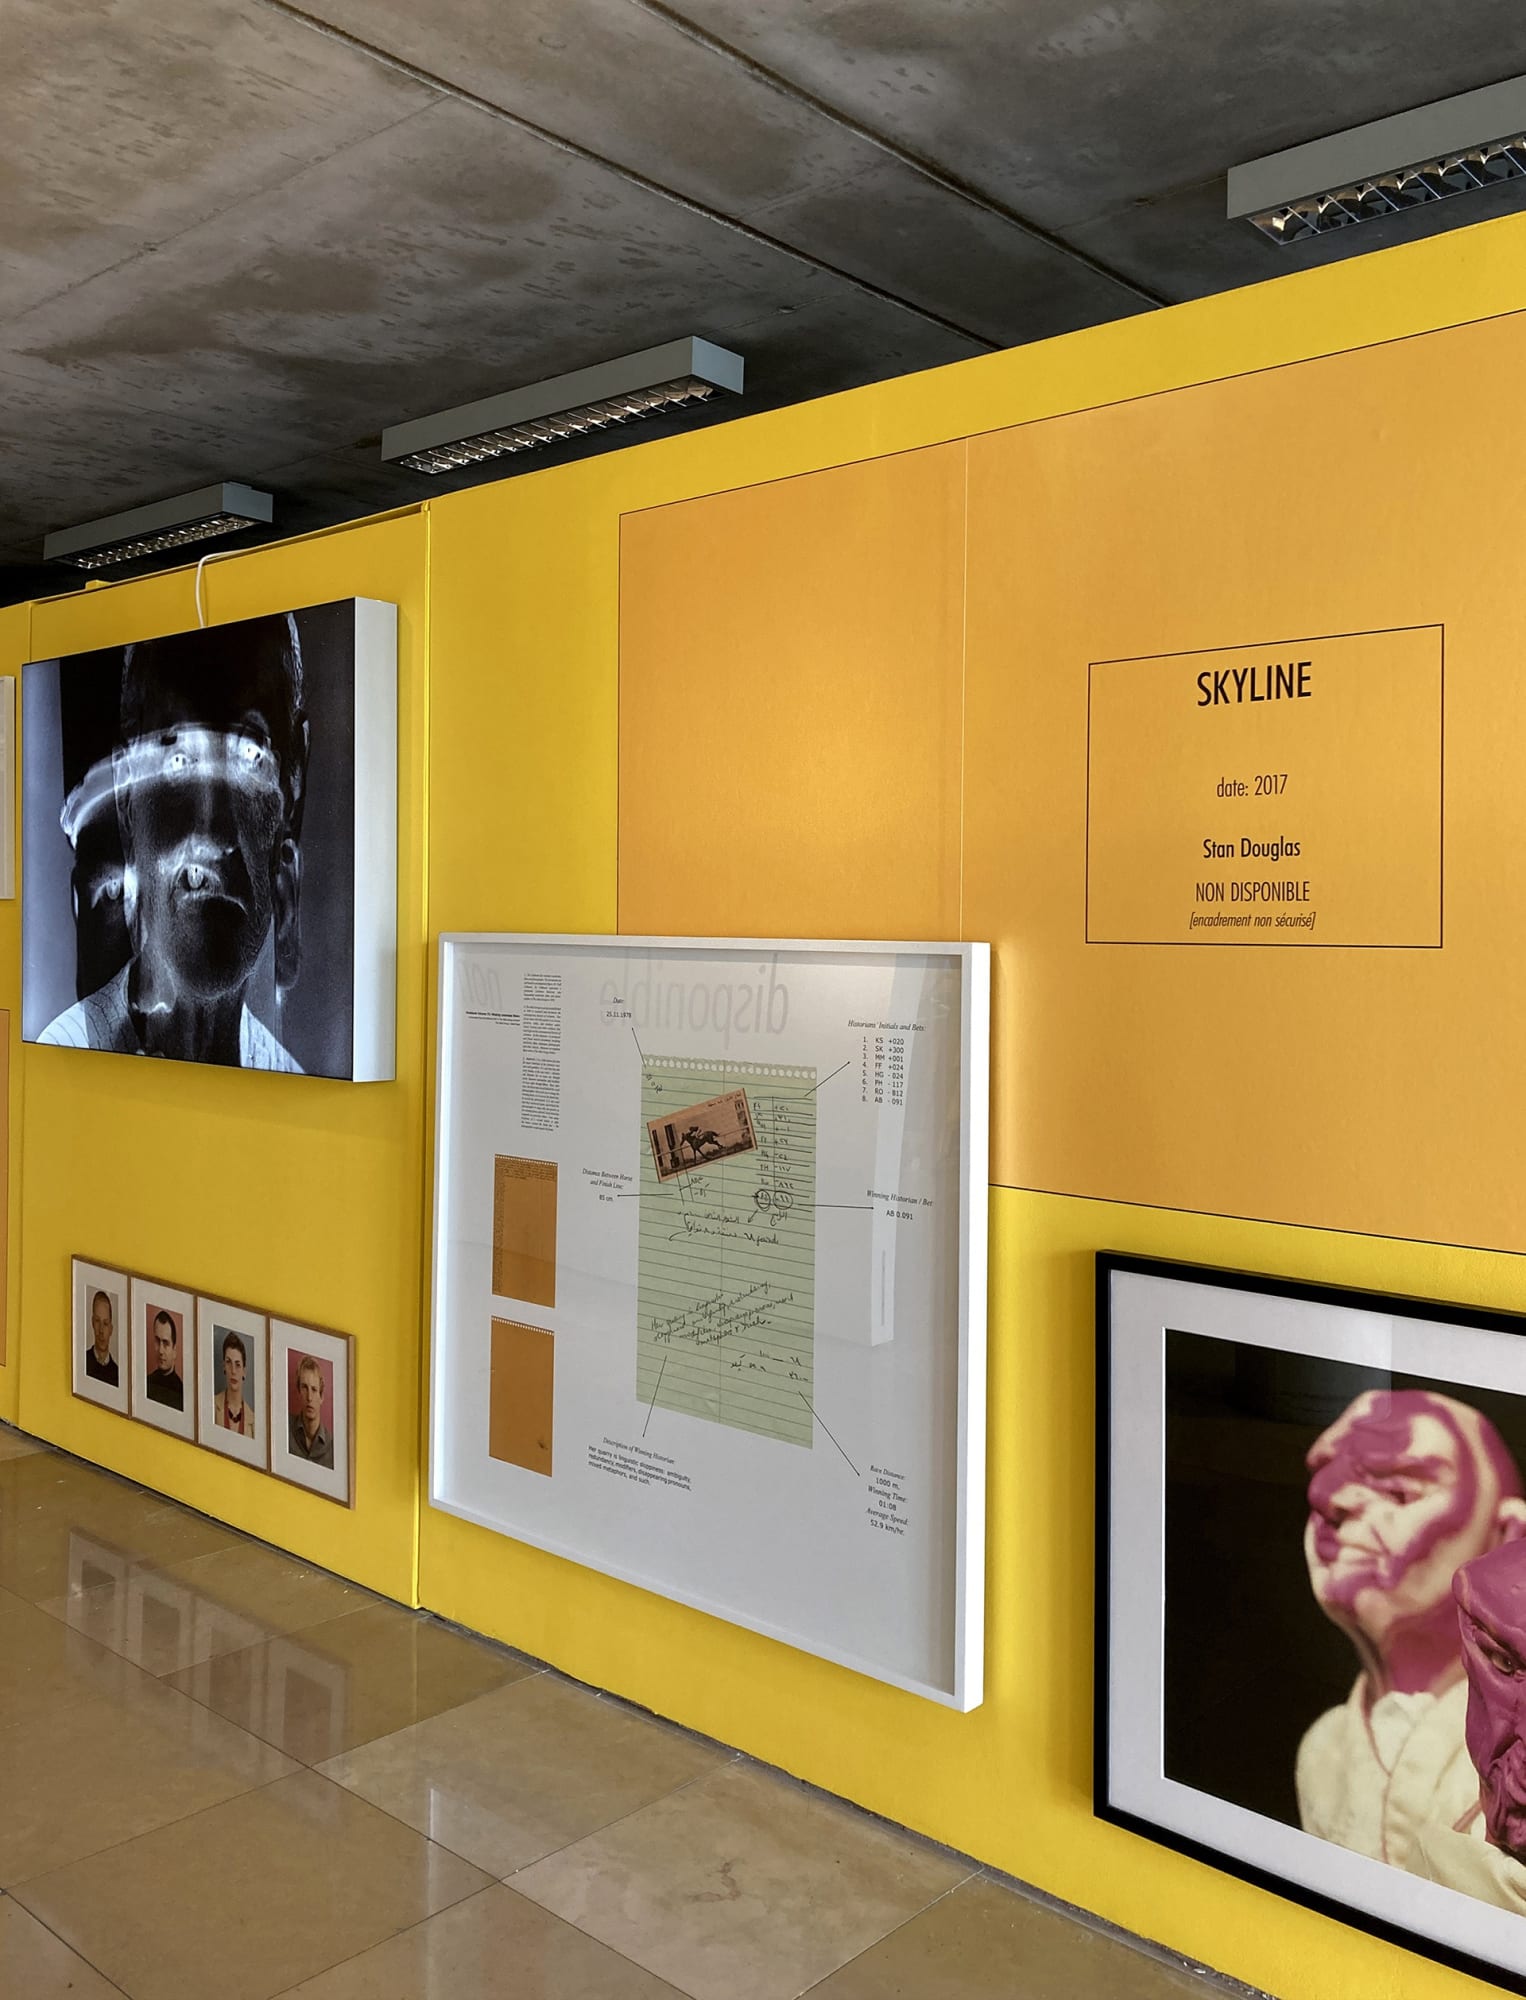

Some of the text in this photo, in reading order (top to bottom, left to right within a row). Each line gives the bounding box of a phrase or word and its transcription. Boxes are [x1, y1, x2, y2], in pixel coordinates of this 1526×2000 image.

[1197, 661, 1312, 706] SKYLINE
[1217, 774, 1288, 797] date: 2017
[1203, 836, 1300, 861] Stan Douglas
[1196, 881, 1310, 902] NON DISPONIBLE
[1189, 912, 1316, 930] [encadrement non sécurisé]
[888, 1046, 904, 1054] +300
[888, 1055, 904, 1063] +001
[866, 1190, 890, 1201] Winning
[890, 1193, 917, 1204] Historian
[886, 1209, 895, 1217] AB
[876, 1477, 891, 1487] 1000
[868, 1485, 891, 1500] Winning
[866, 1507, 889, 1520] Average
[870, 1519, 884, 1529] 52.9
